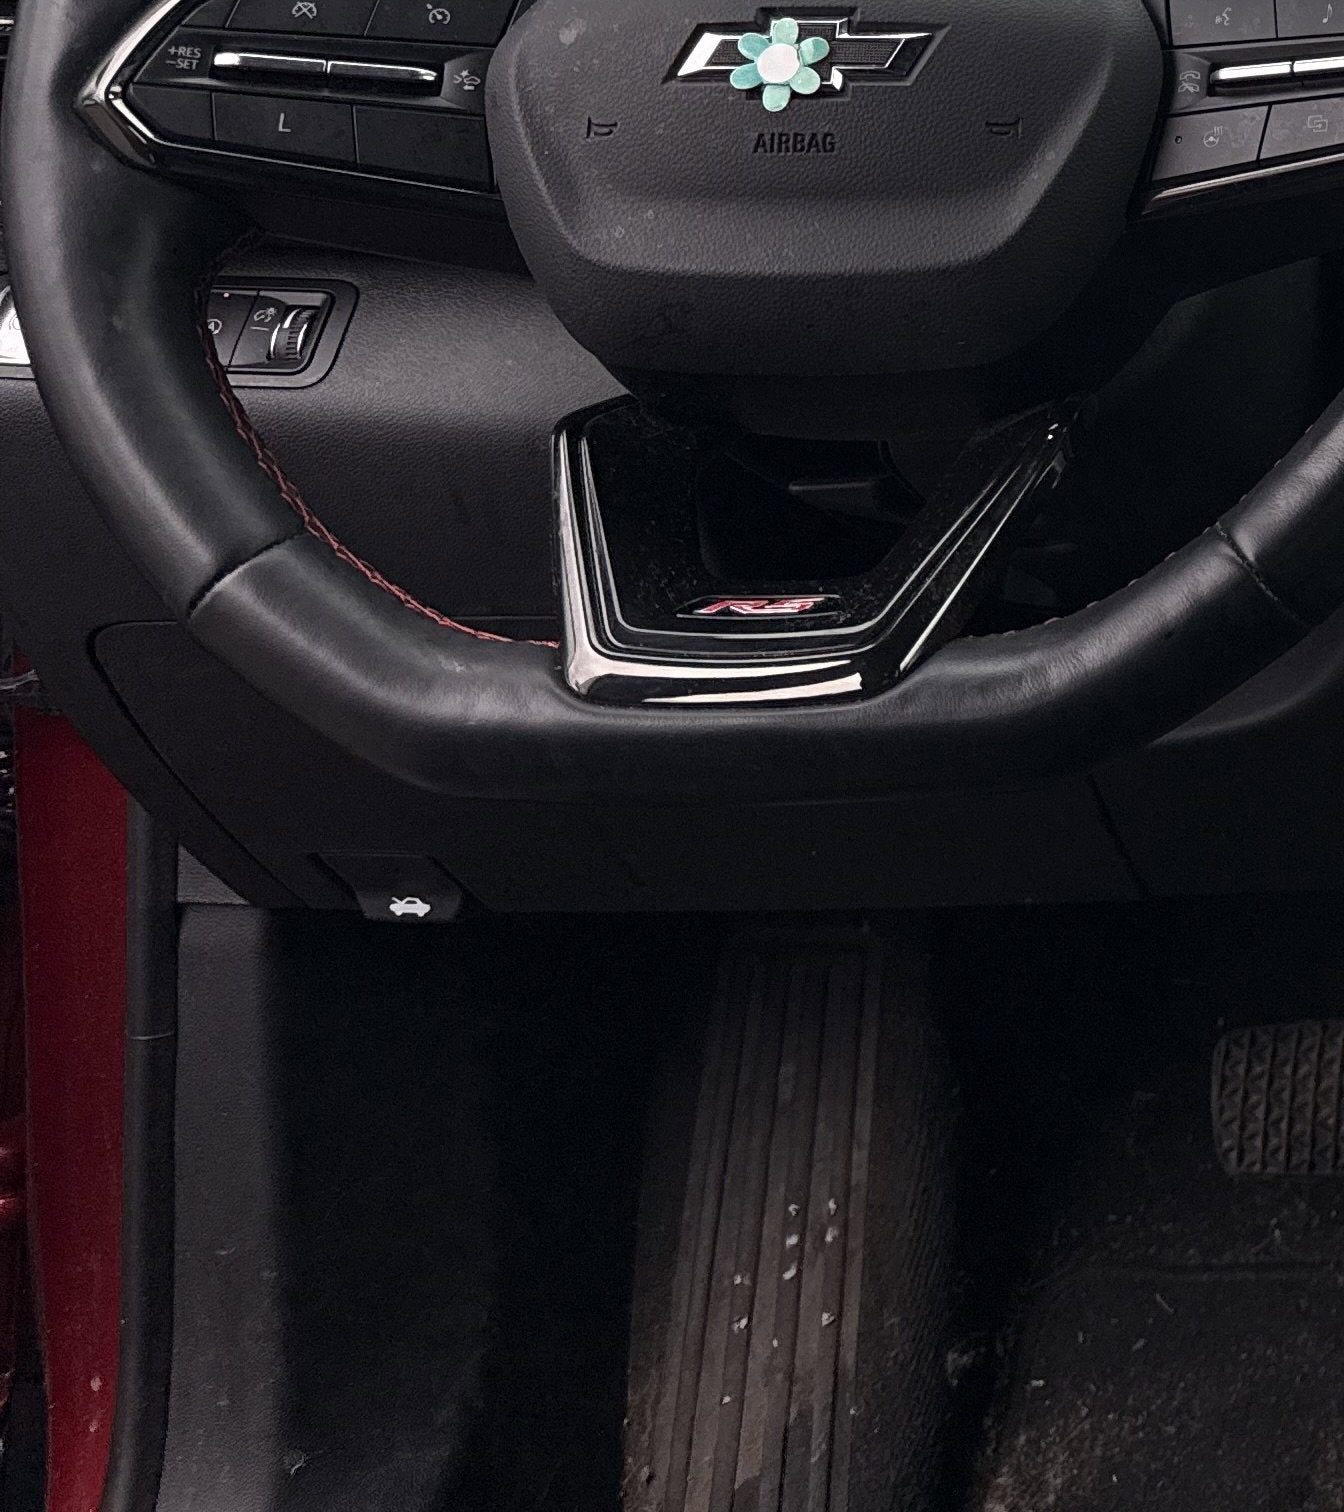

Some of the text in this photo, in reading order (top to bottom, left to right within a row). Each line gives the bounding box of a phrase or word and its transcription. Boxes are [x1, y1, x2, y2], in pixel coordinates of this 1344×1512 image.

[278, 113, 291, 133] L
[752, 132, 837, 155] AIRBAG
[694, 597, 823, 614] RS
